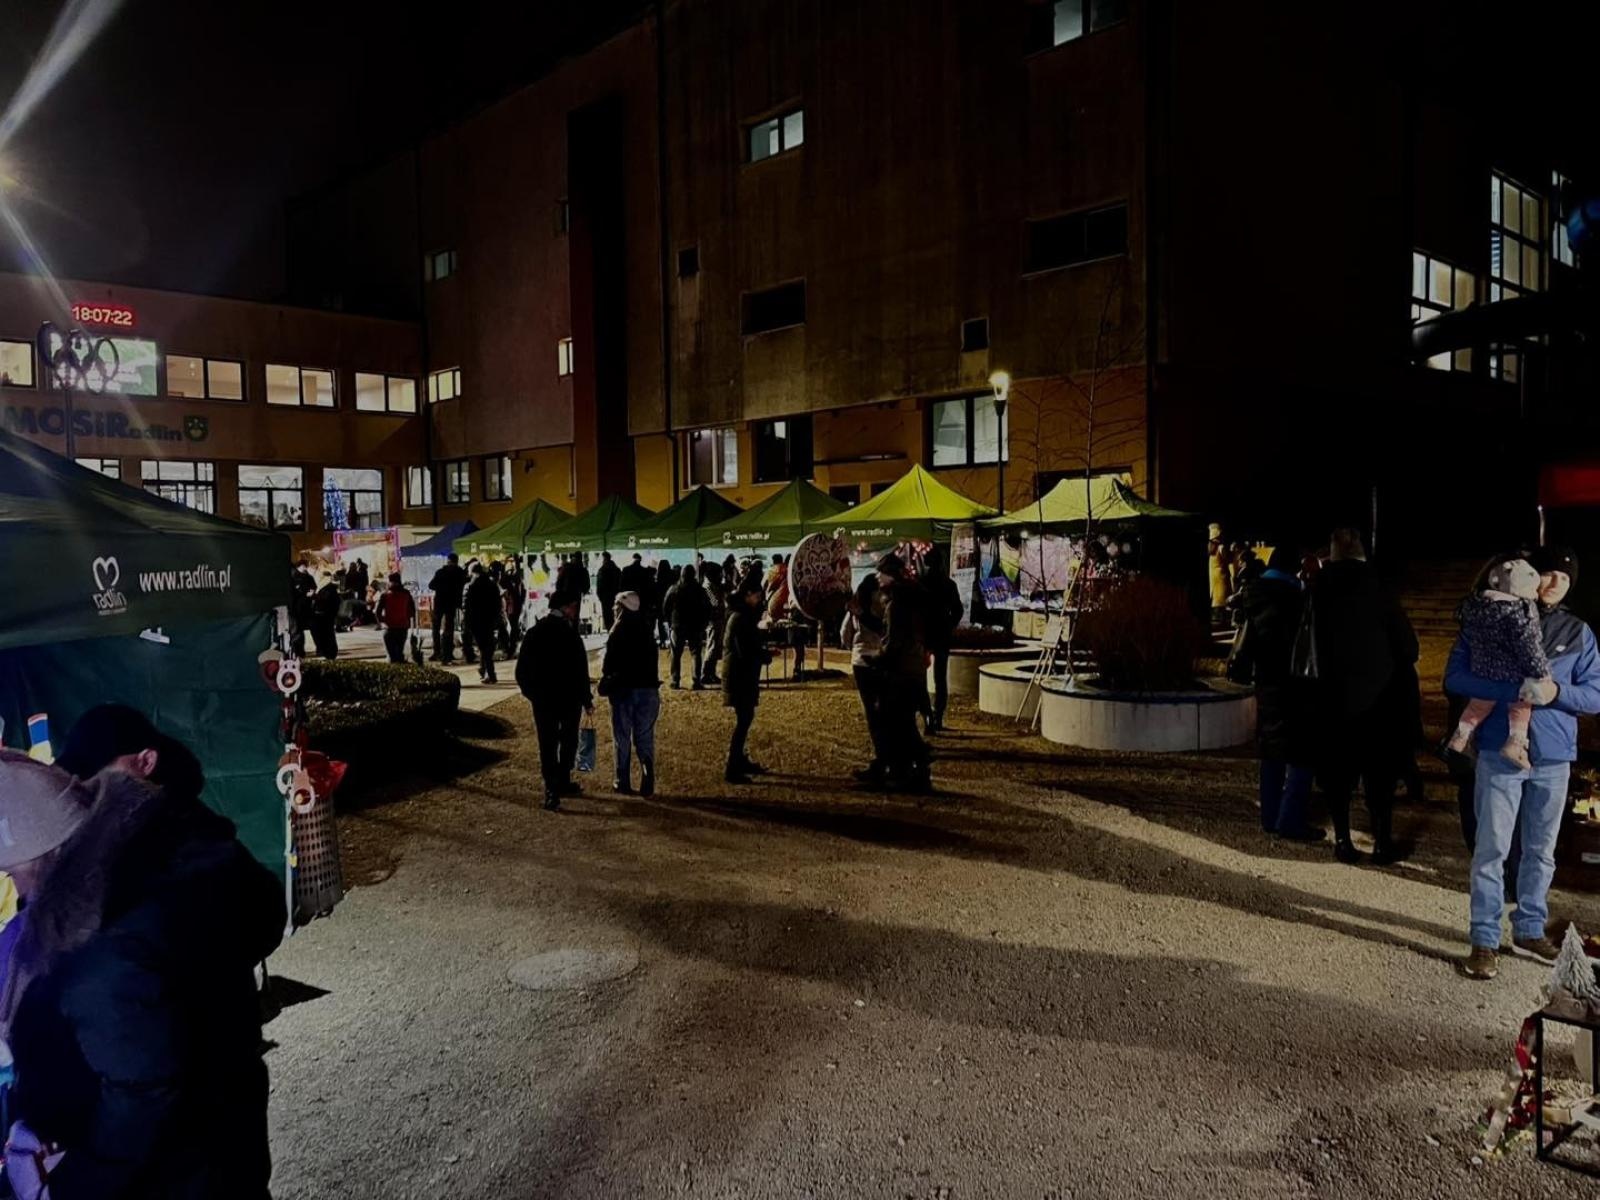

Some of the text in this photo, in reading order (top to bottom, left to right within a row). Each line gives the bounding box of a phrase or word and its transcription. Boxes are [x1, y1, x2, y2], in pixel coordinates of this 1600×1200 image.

[72, 306, 133, 326] 18:07:22
[139, 564, 231, 592] www.radlin.pl
[92, 589, 127, 609] radlin
